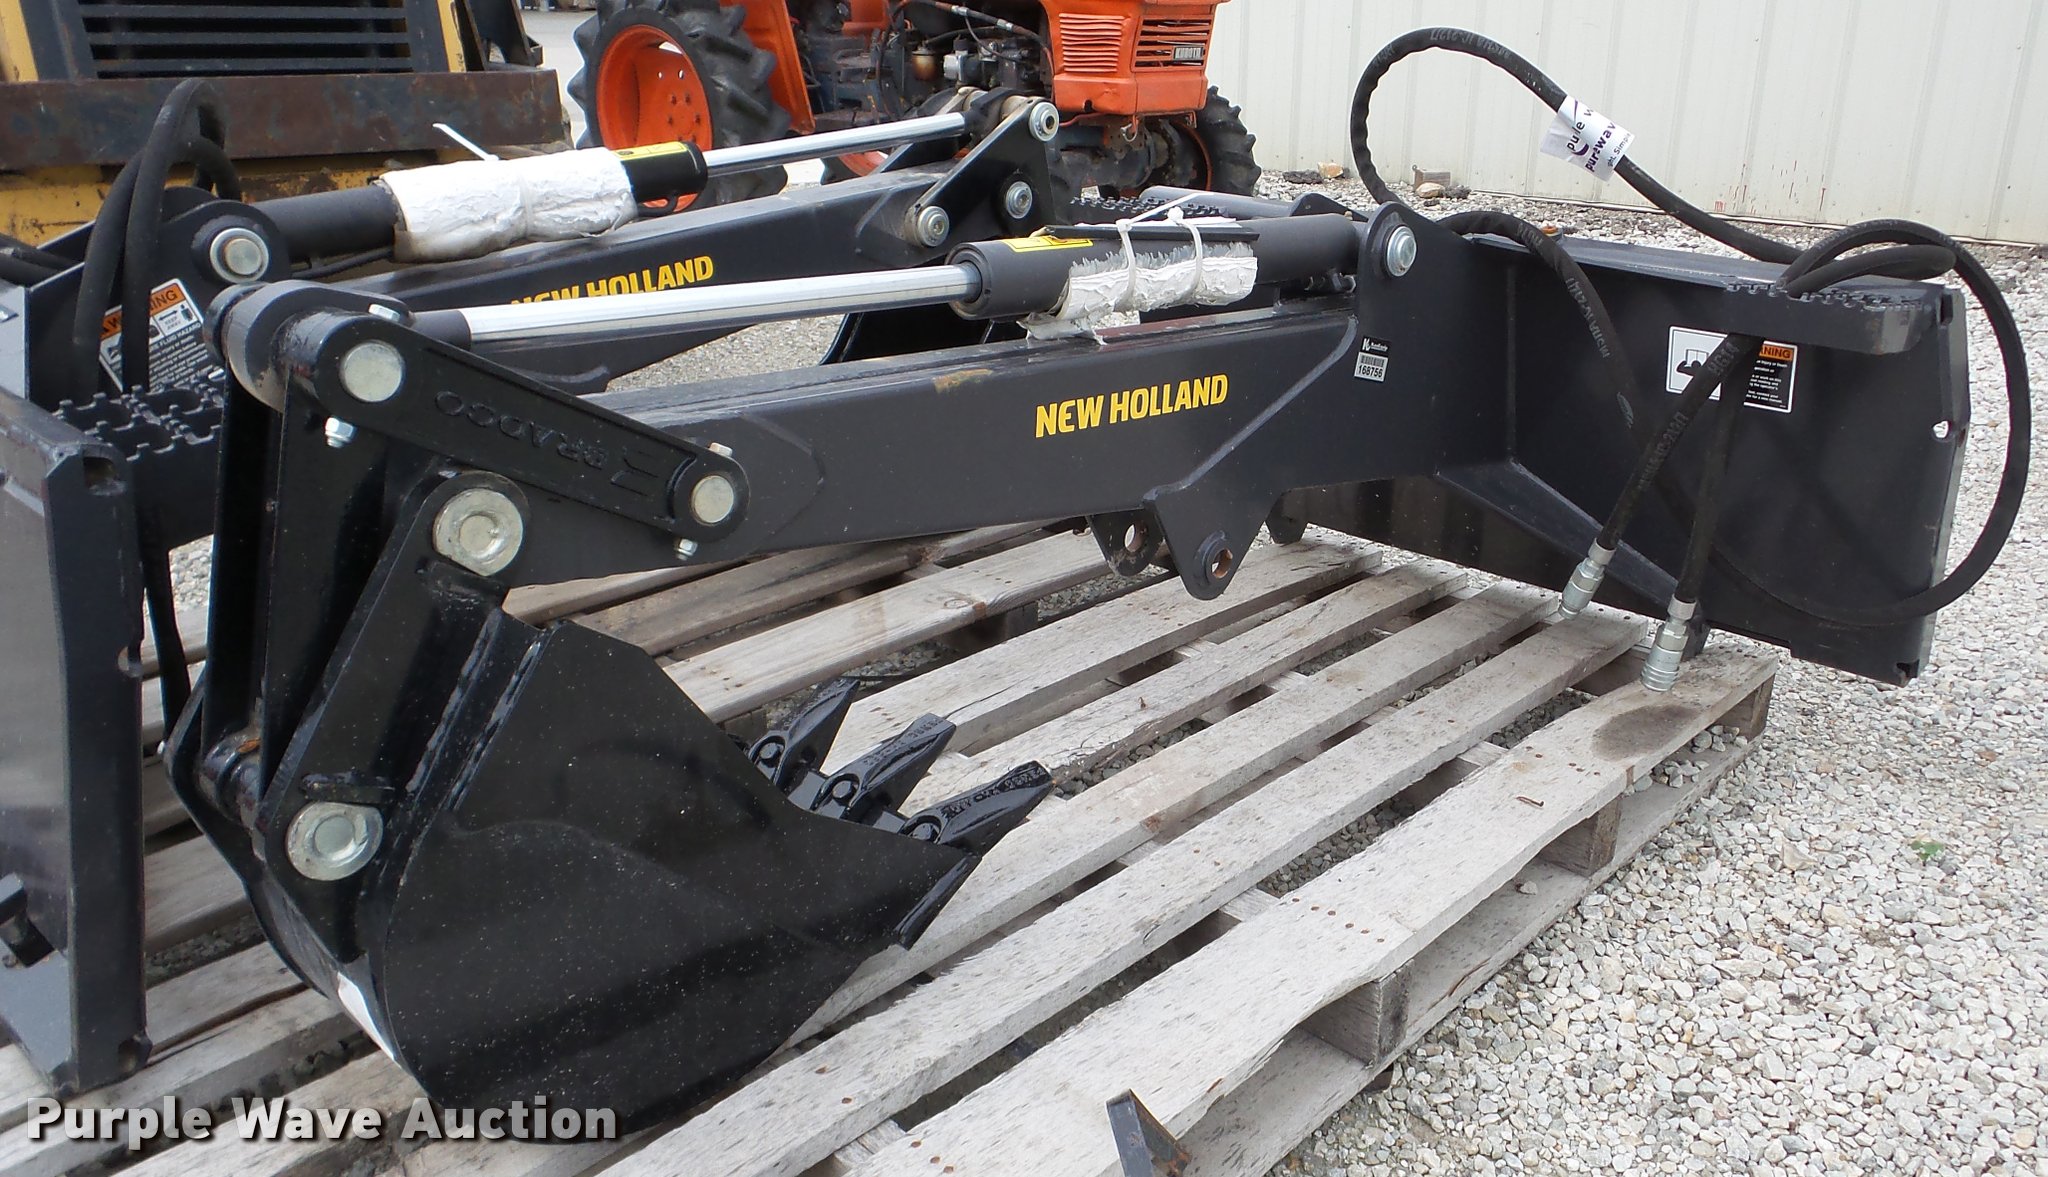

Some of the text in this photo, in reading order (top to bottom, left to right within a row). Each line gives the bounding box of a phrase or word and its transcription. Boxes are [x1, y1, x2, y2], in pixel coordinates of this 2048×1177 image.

[586, 255, 714, 298] HOLLAND
[1035, 374, 1229, 438] NEW HOLLAND
